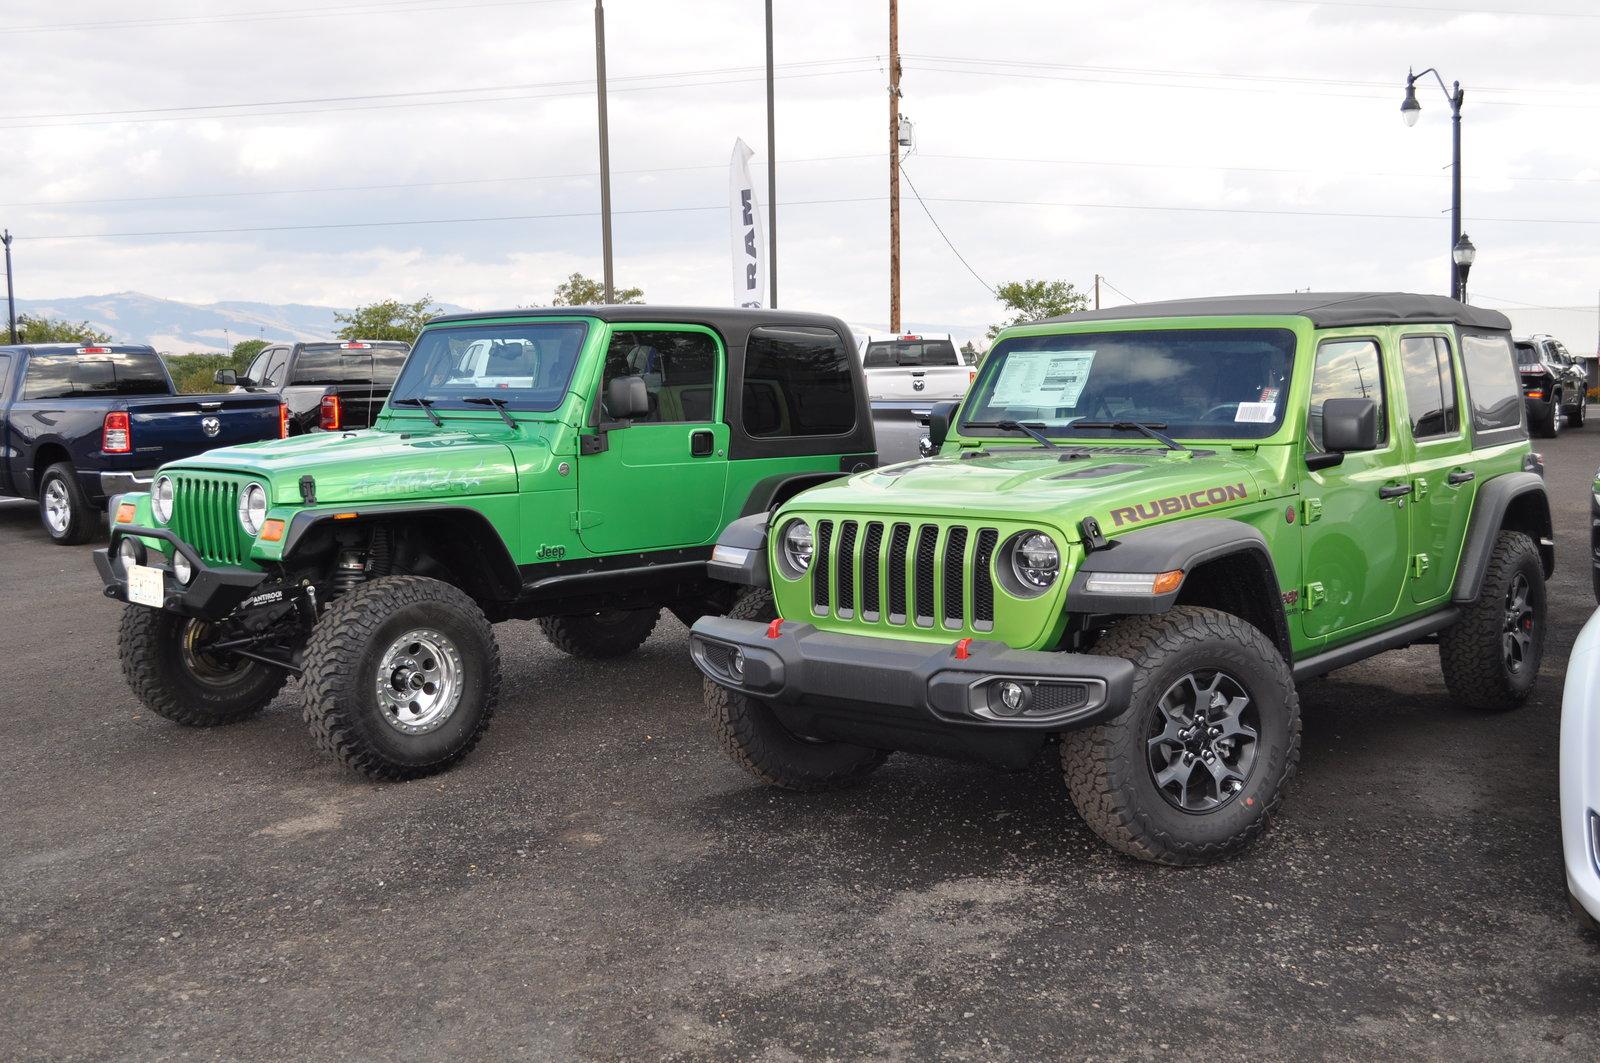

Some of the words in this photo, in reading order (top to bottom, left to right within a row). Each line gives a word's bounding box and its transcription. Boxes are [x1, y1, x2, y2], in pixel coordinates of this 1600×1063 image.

[740, 189, 757, 290] RAM
[1110, 482, 1247, 527] RUBICON
[536, 543, 566, 560] Jeep
[253, 590, 283, 602] ANTIROCK
[1280, 591, 1299, 606] eep
